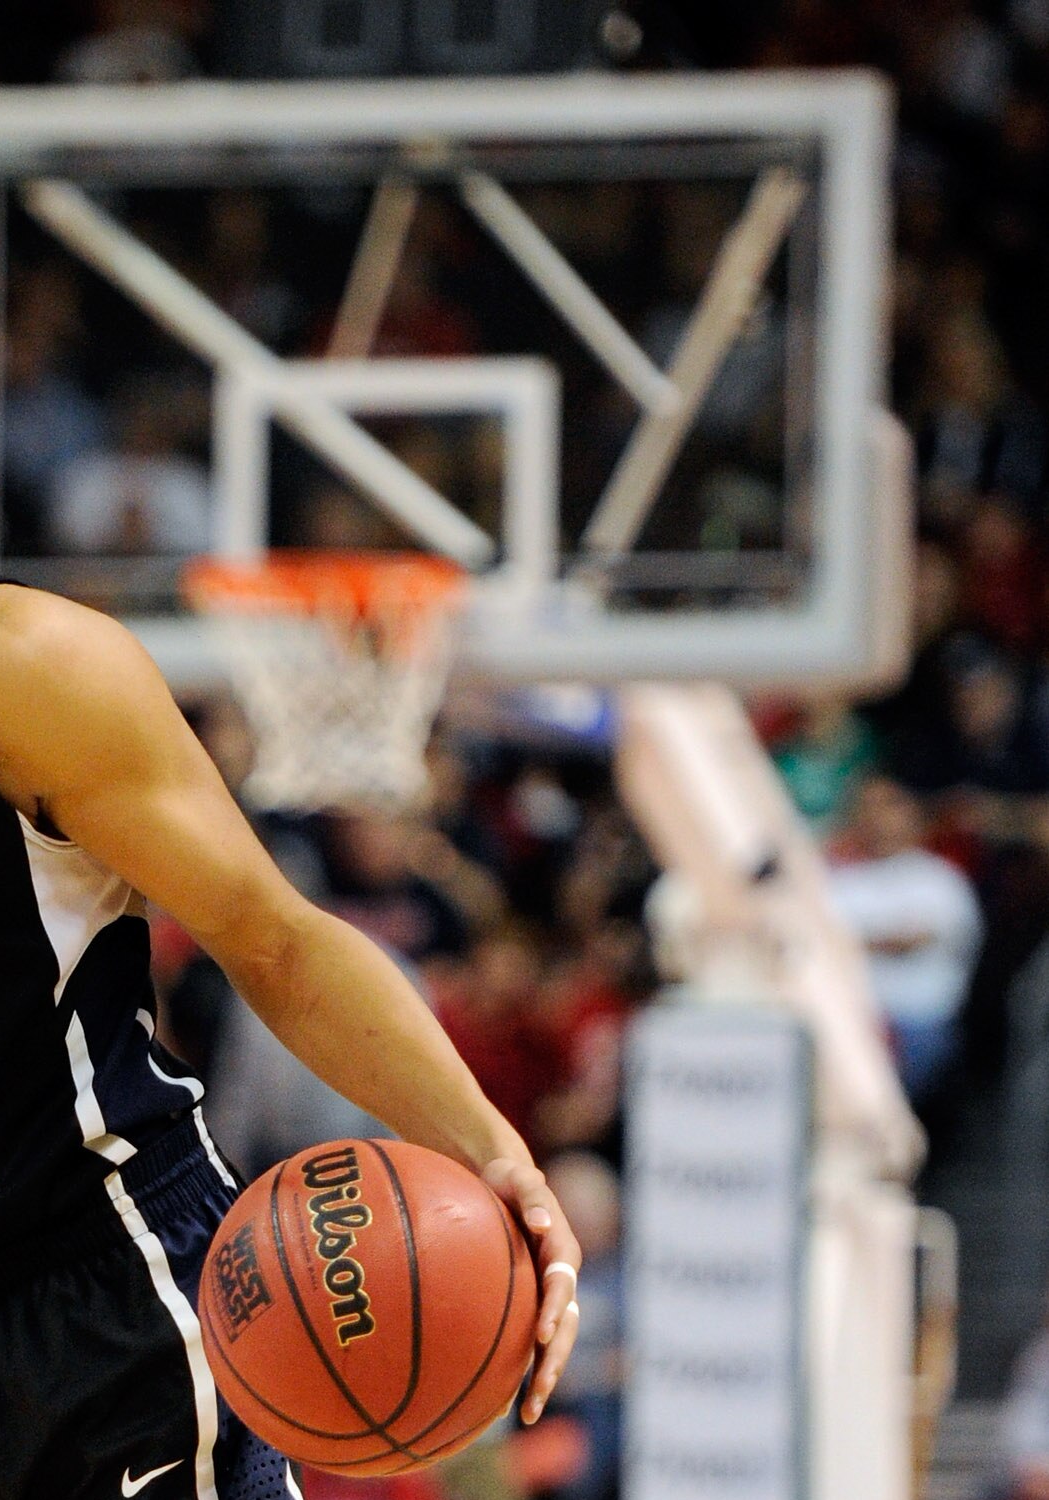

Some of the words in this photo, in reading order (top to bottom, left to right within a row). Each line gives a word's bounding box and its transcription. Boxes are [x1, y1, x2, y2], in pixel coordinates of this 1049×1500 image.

[216, 1243, 251, 1328] COAST
[233, 1225, 273, 1312] WEST
[301, 1146, 375, 1347] Wilson
